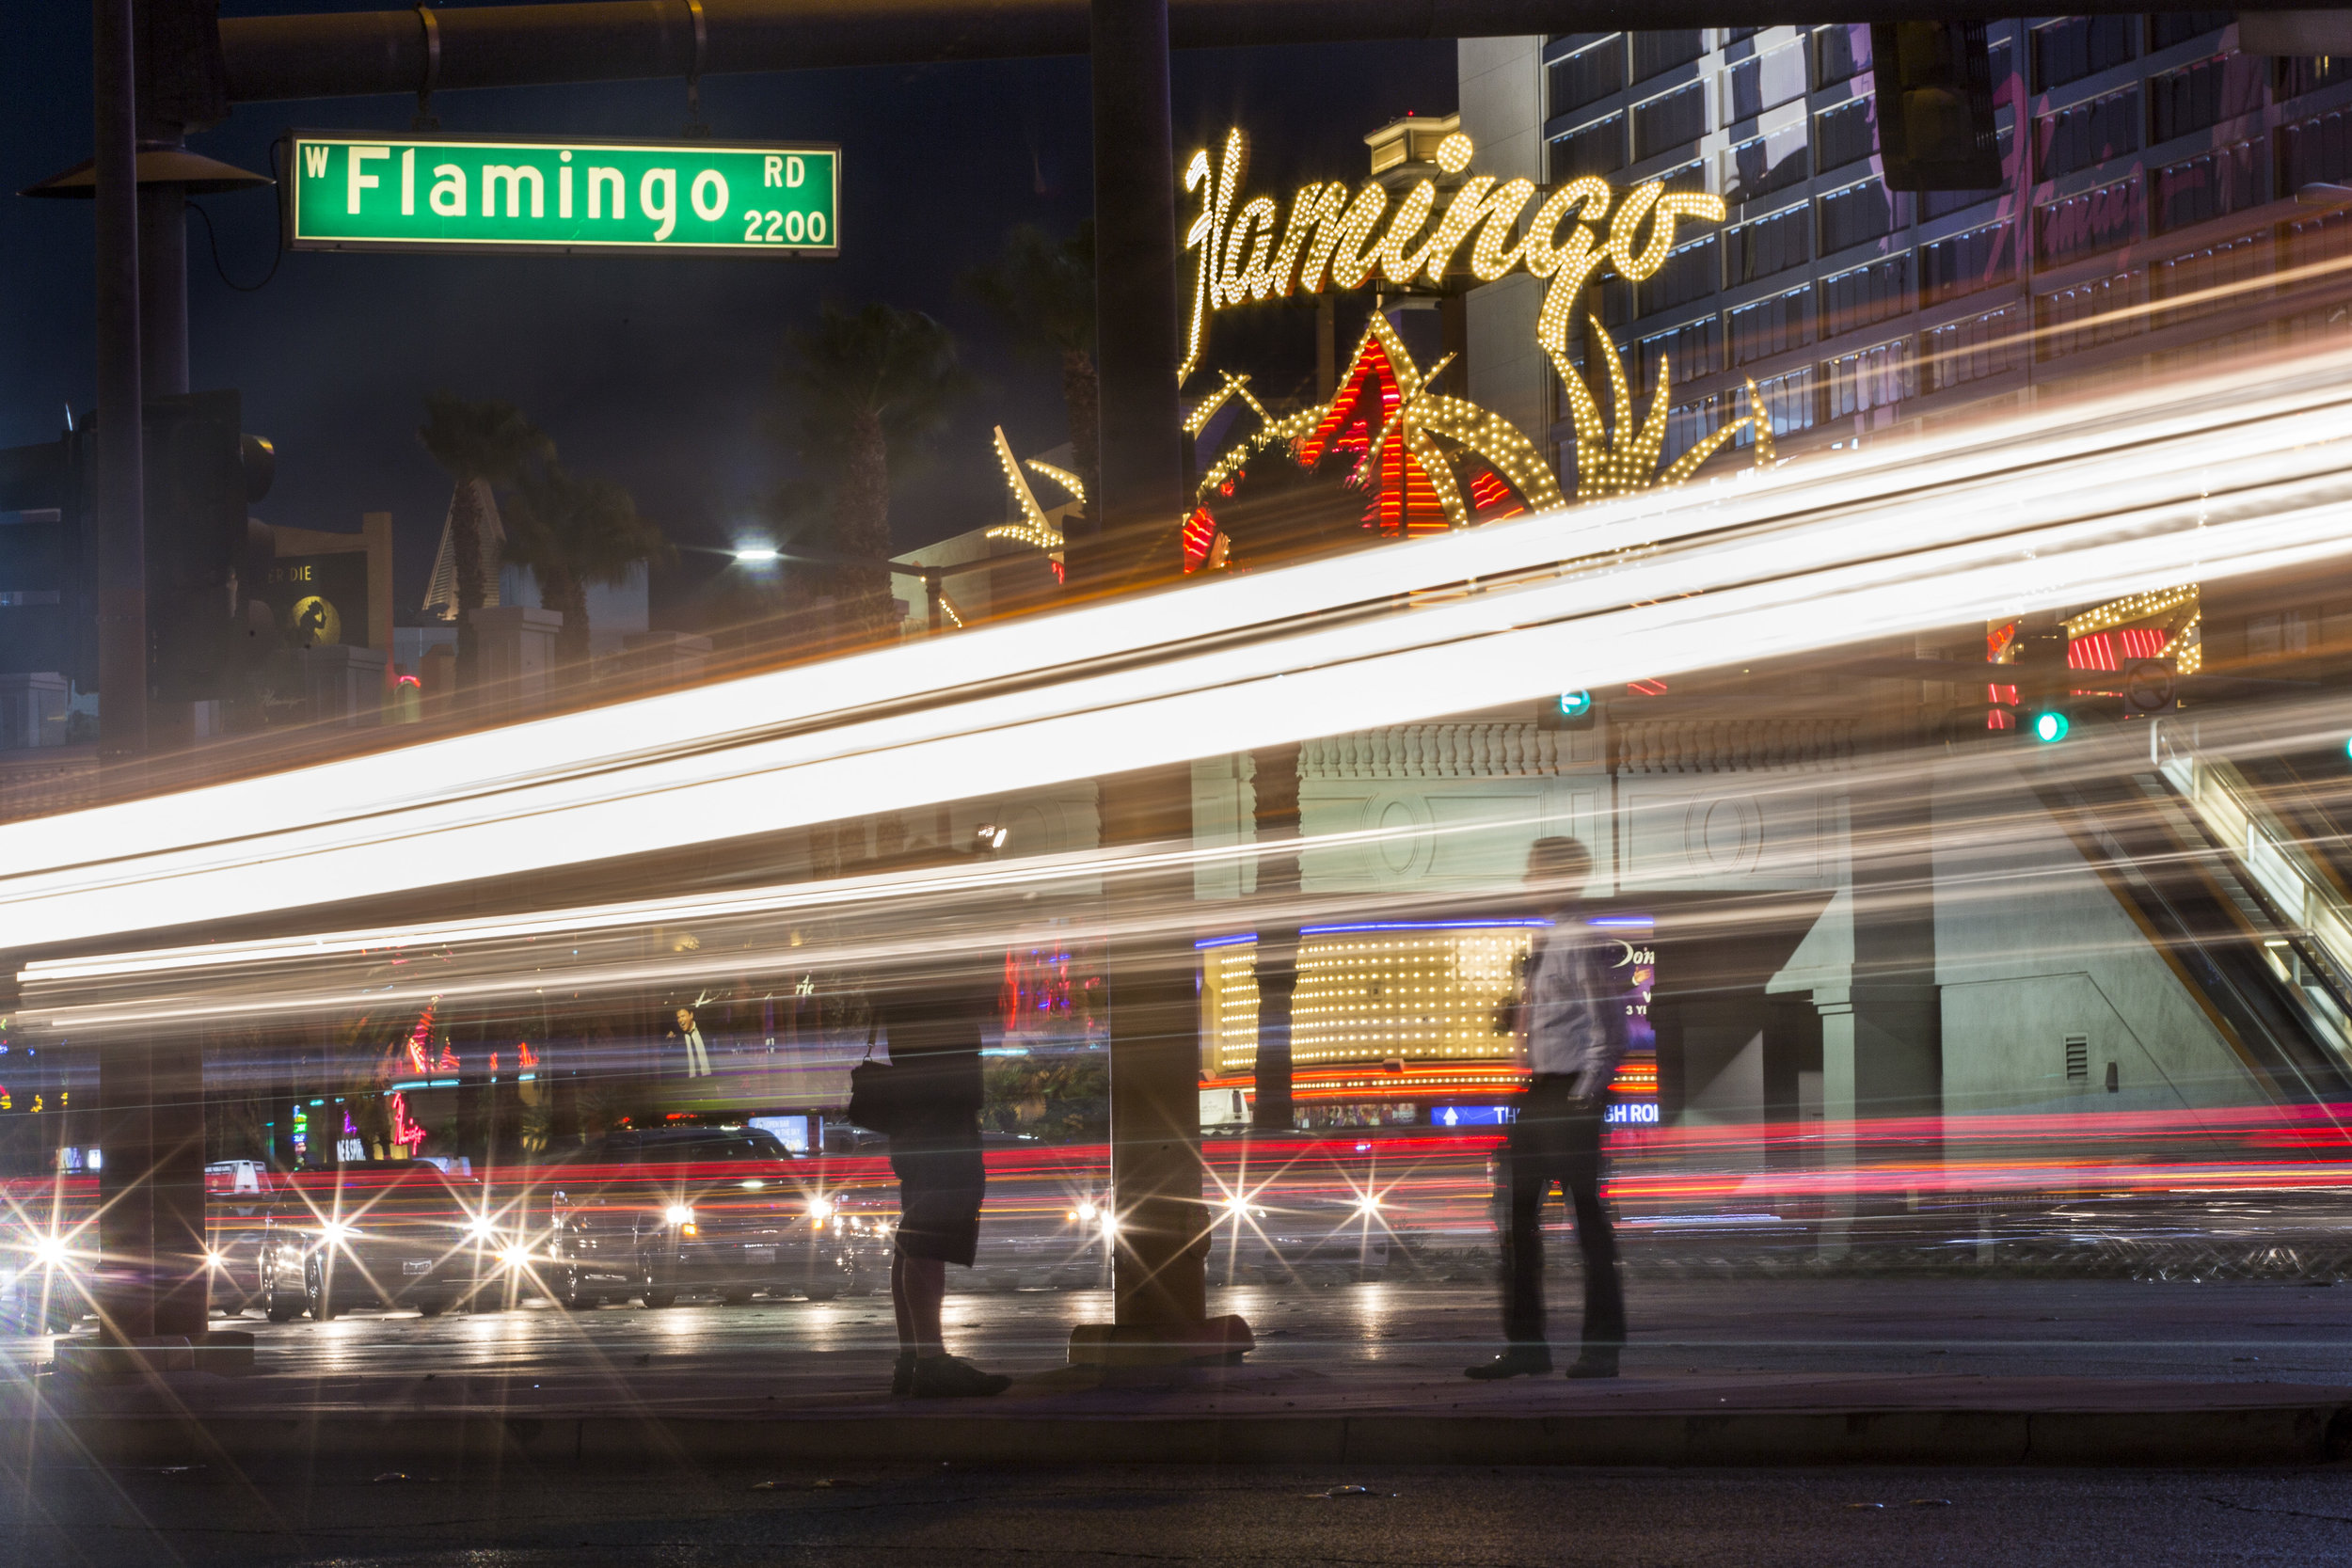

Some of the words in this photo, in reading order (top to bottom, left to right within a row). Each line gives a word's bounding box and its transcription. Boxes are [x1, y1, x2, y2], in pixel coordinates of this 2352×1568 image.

[304, 146, 329, 179] W
[347, 146, 730, 243] Flamingo
[764, 155, 806, 188] RD
[743, 210, 827, 243] 2200
[1178, 127, 1726, 388] Flamingo
[289, 565, 312, 582] DIE
